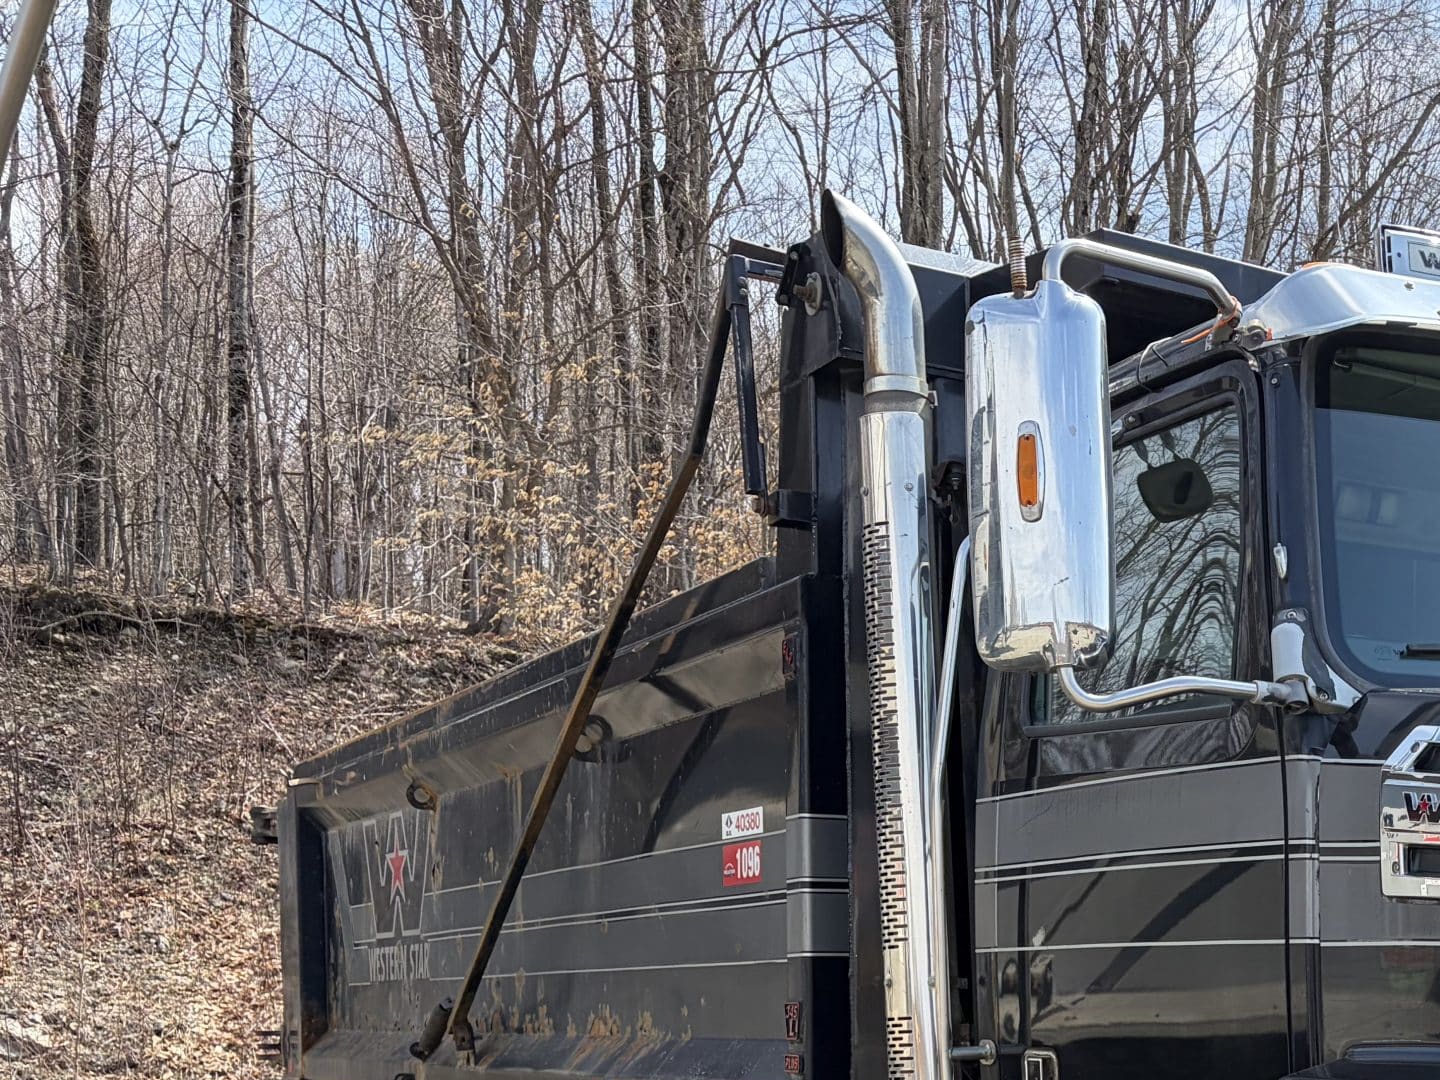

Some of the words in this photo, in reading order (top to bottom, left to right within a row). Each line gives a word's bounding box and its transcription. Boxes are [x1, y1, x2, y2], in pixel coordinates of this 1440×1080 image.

[736, 812, 761, 833] 40380
[736, 845, 761, 879] 1096
[368, 944, 407, 983] WESTERN
[409, 942, 431, 980] STAR
